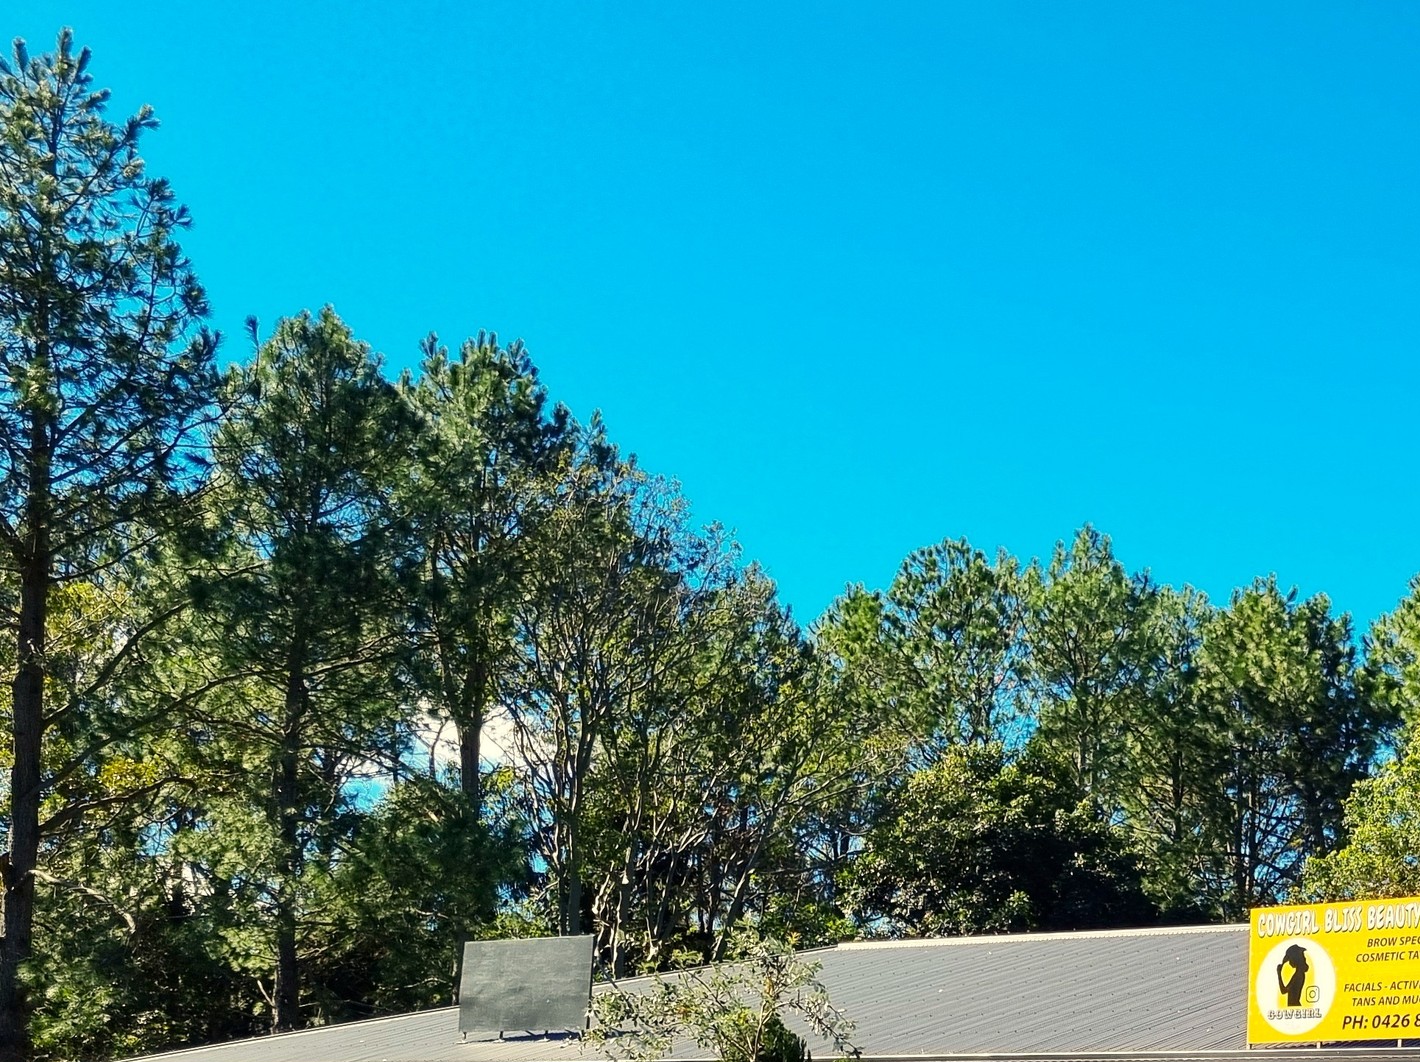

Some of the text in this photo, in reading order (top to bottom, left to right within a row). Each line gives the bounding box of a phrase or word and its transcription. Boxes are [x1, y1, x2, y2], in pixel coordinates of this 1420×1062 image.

[1258, 910, 1319, 938] COWGIRL
[1324, 905, 1363, 933] BLISS
[1367, 937, 1398, 947] BROW
[1355, 951, 1405, 963] COSMETIC
[1344, 981, 1383, 992] FACIALS
[1352, 997, 1376, 1006] TANS
[1378, 995, 1400, 1005] AND
[1267, 1008, 1322, 1020] COWGIRL
[1342, 1014, 1369, 1030] PH:
[1372, 1013, 1410, 1028] 0426
